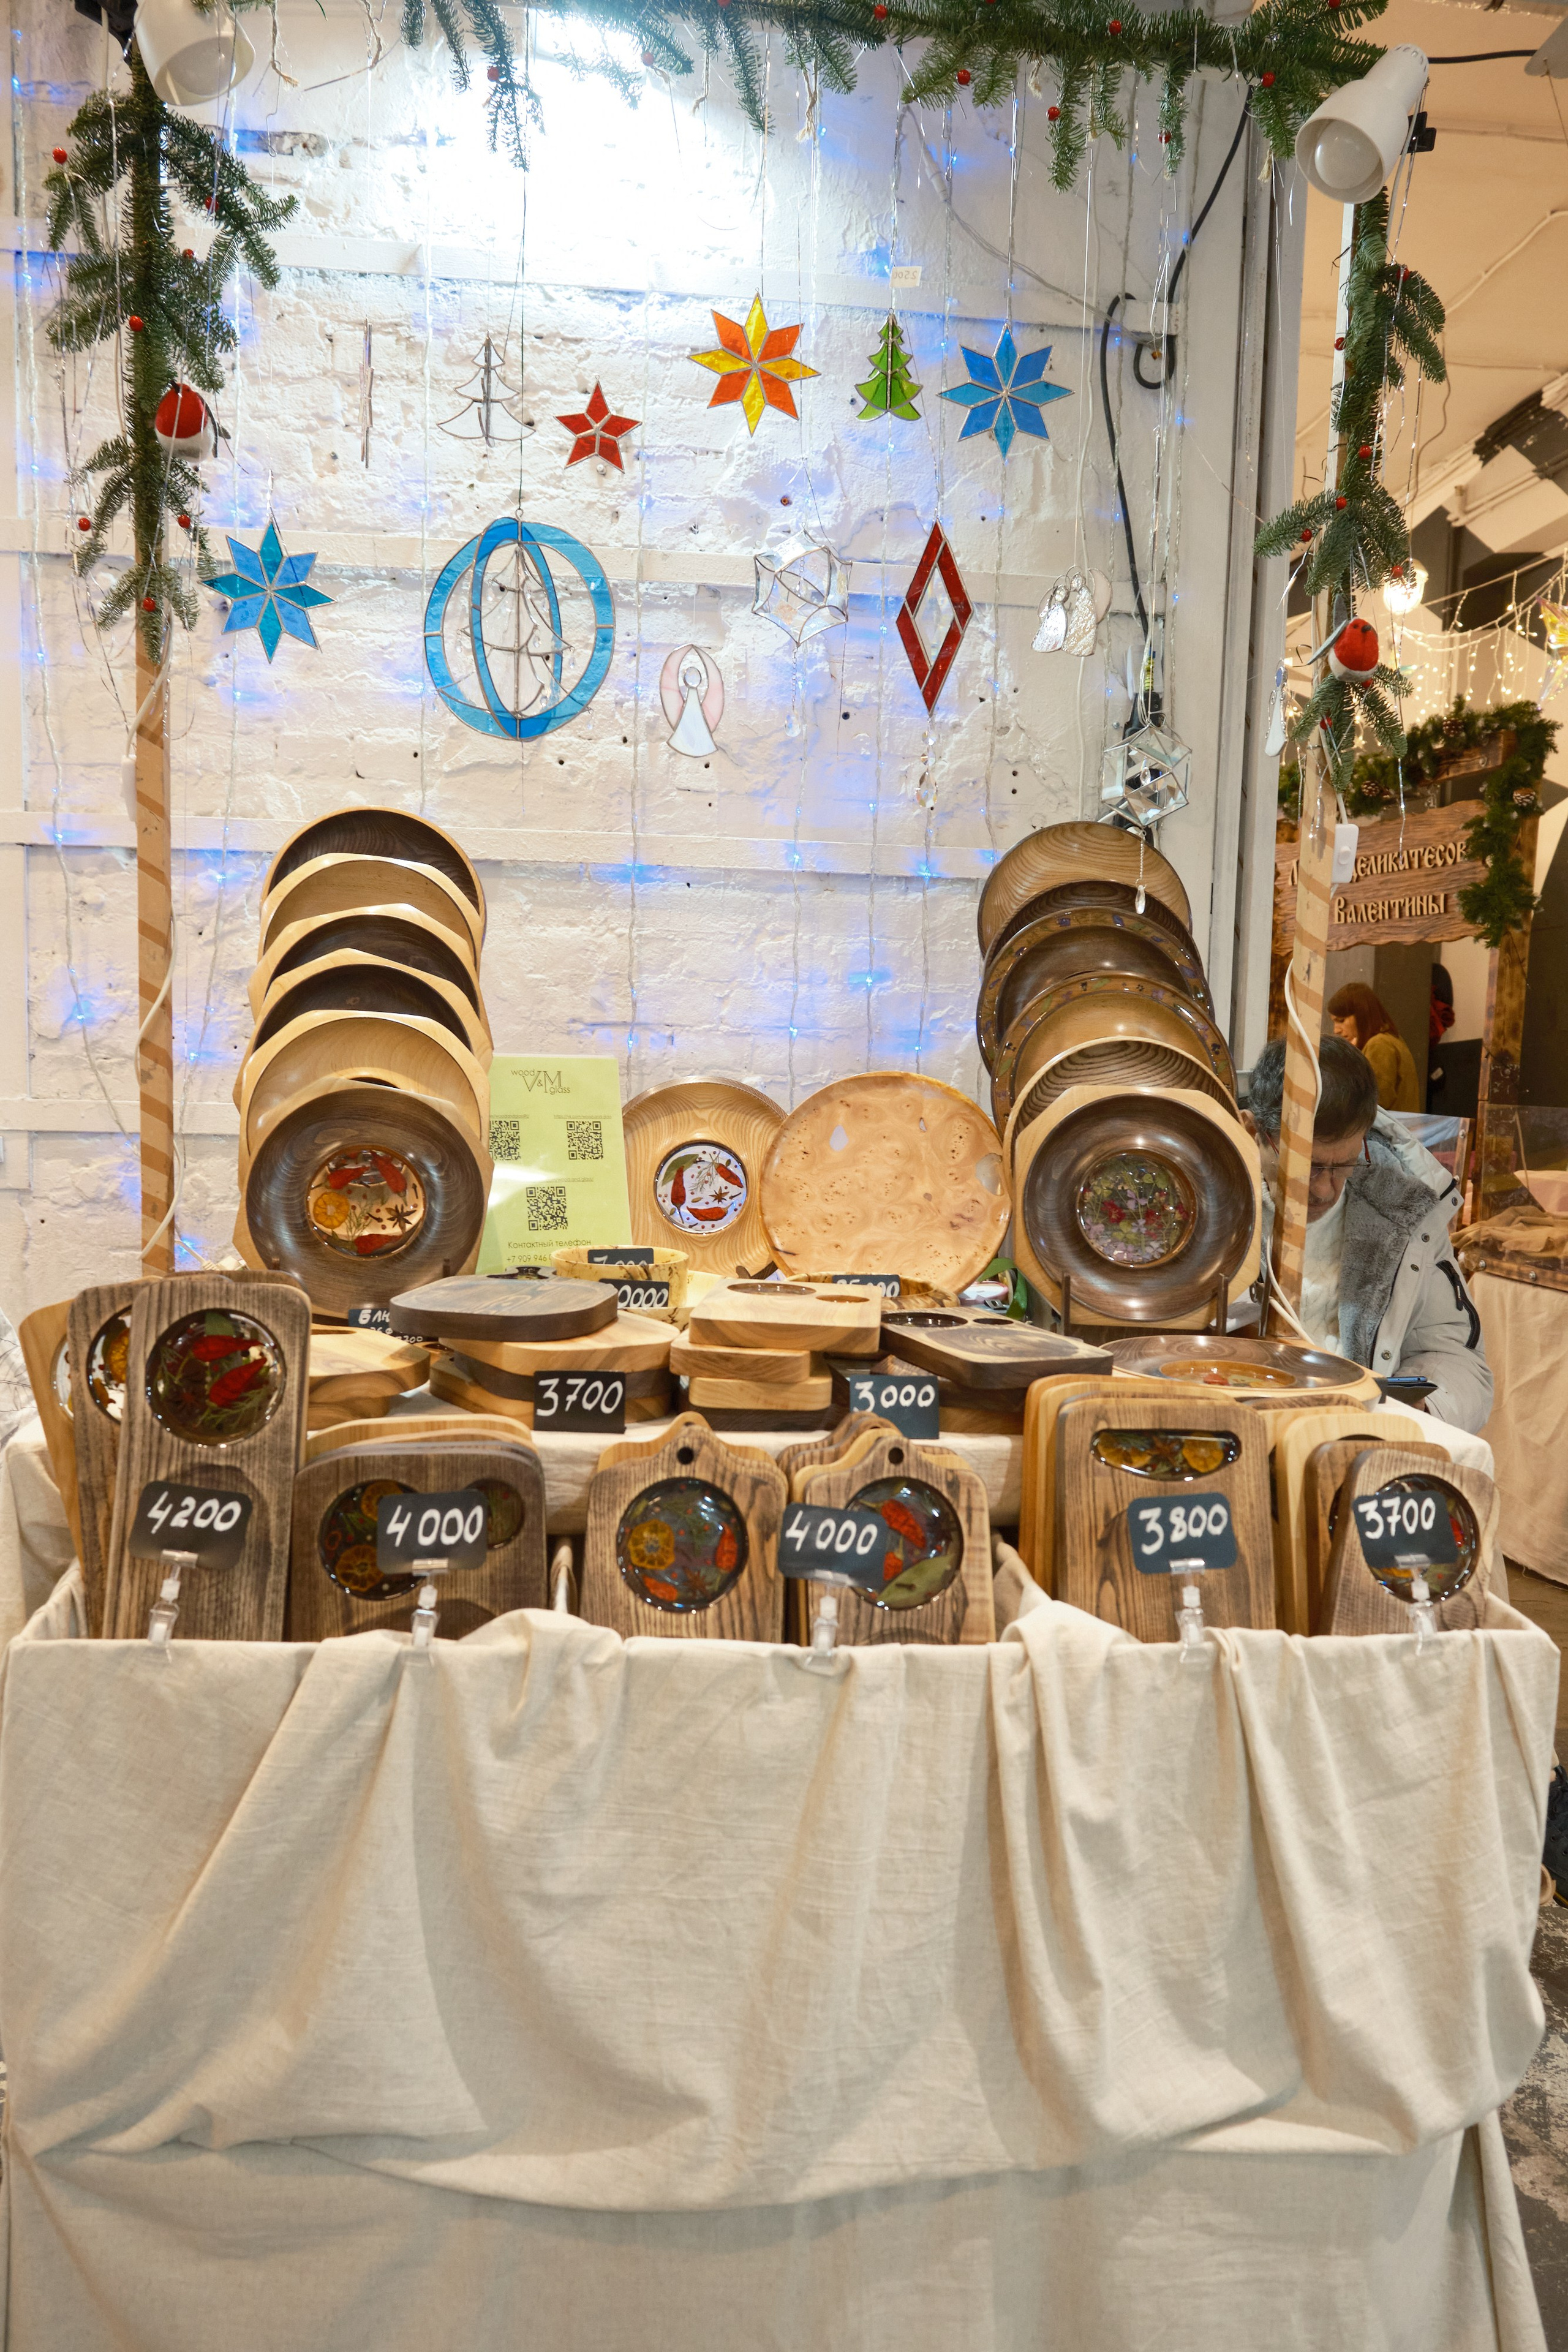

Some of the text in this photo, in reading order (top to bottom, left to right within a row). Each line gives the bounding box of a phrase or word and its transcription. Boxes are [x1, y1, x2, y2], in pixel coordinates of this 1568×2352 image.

[549, 1085, 570, 1095] glass
[508, 1238, 591, 1249] Контактный телефон
[536, 1378, 624, 1417] 3700
[148, 1491, 241, 1534] 4200
[386, 1504, 483, 1547] 4000
[785, 1510, 878, 1555] 4000
[1137, 1503, 1228, 1555] 3800
[1358, 1496, 1436, 1539] 3700
